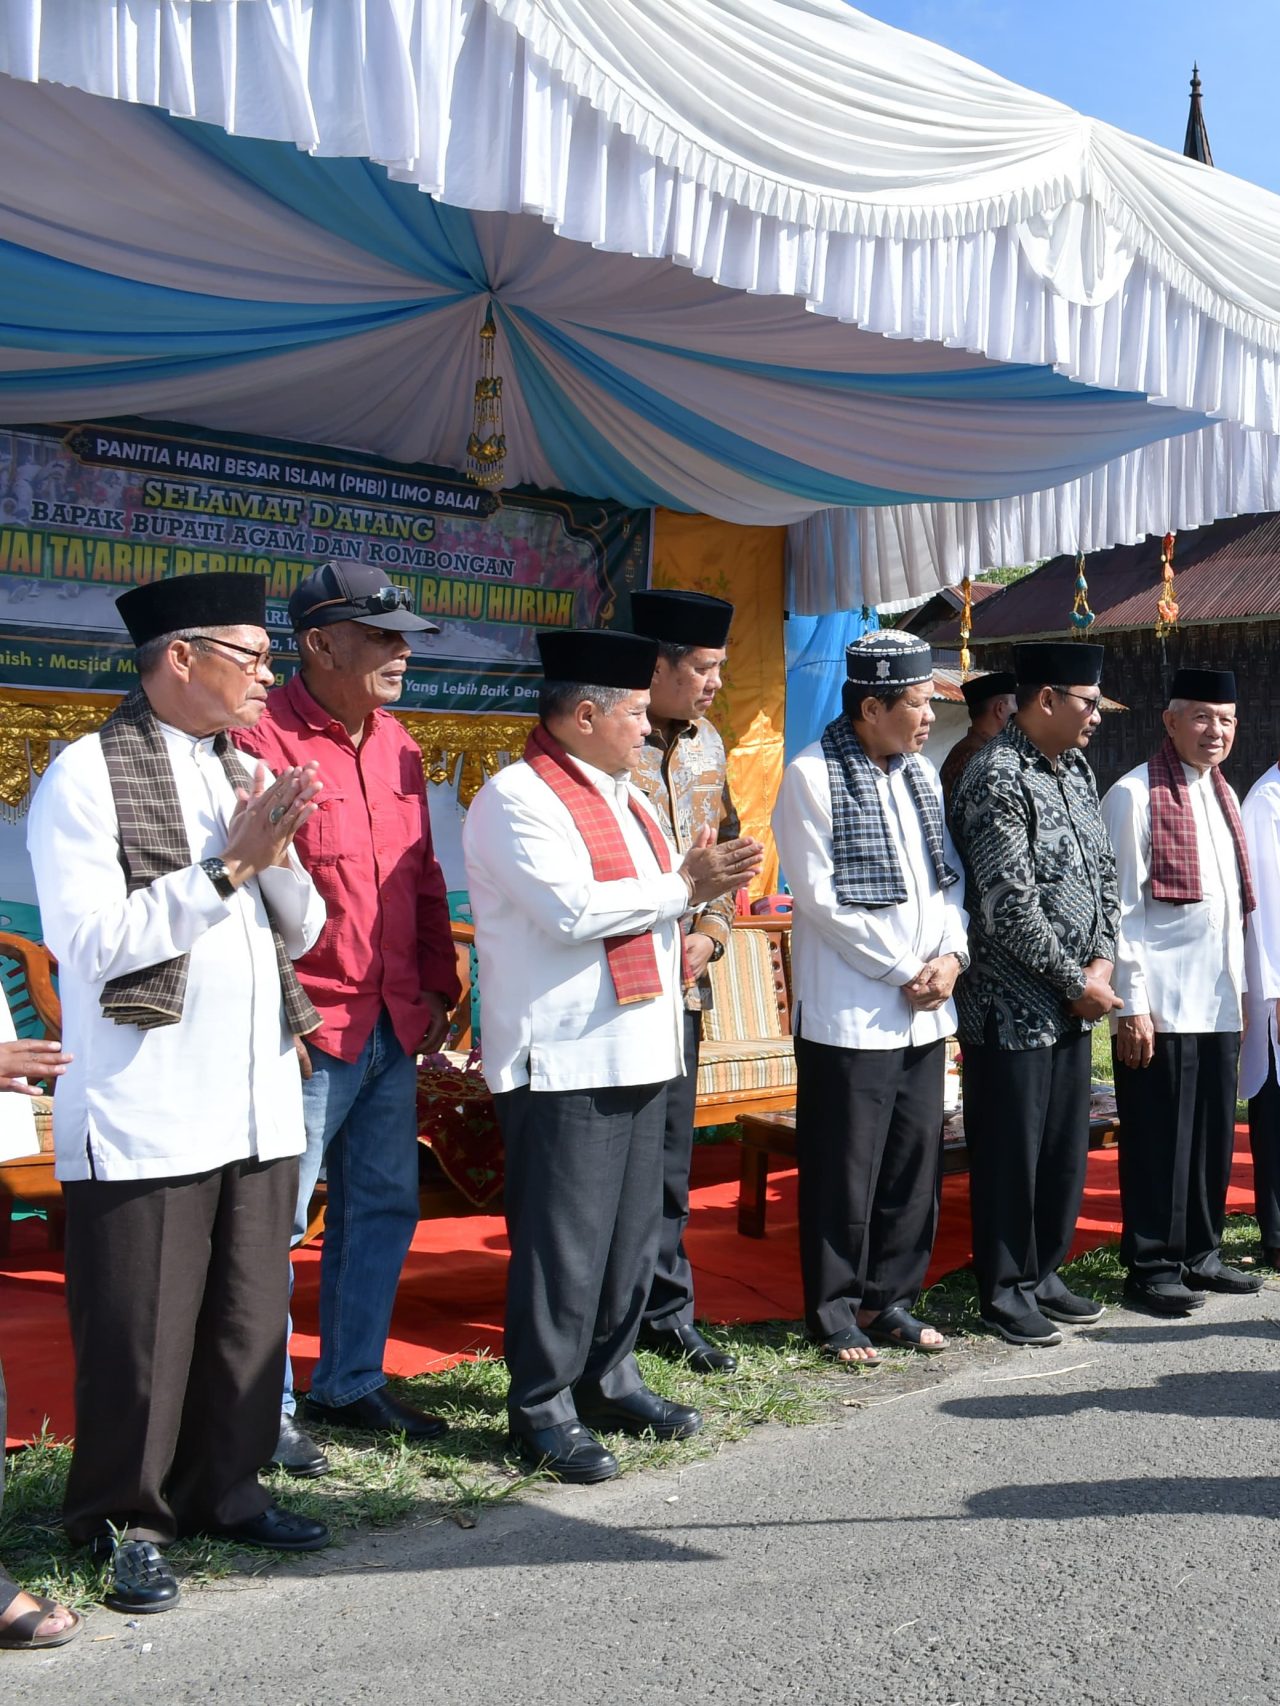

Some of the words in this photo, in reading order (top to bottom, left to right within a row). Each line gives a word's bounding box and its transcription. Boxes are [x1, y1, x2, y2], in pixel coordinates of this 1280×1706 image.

[96, 438, 171, 466] PANITIA
[175, 449, 220, 473] HARI
[224, 458, 281, 481] BESAR
[285, 466, 336, 489] ISLAM
[340, 473, 388, 498] (PHBI)
[391, 483, 431, 503] LIMO
[434, 491, 480, 511] BALAI
[30, 500, 125, 531] BAPAK
[132, 512, 224, 542] BUPATI
[231, 528, 305, 552] AGAM
[312, 536, 362, 559] DAN
[368, 542, 516, 578] ROMBONGAN
[145, 479, 302, 524] SELAMAT
[311, 502, 436, 543] DATANG
[50, 534, 169, 585] TA'ARUF
[420, 578, 485, 619] BARU
[488, 584, 574, 627] HIJRIAH
[49, 653, 112, 675] Masjid
[405, 678, 439, 696] Yang
[442, 682, 477, 696] Lebih
[480, 684, 509, 698] Baik
